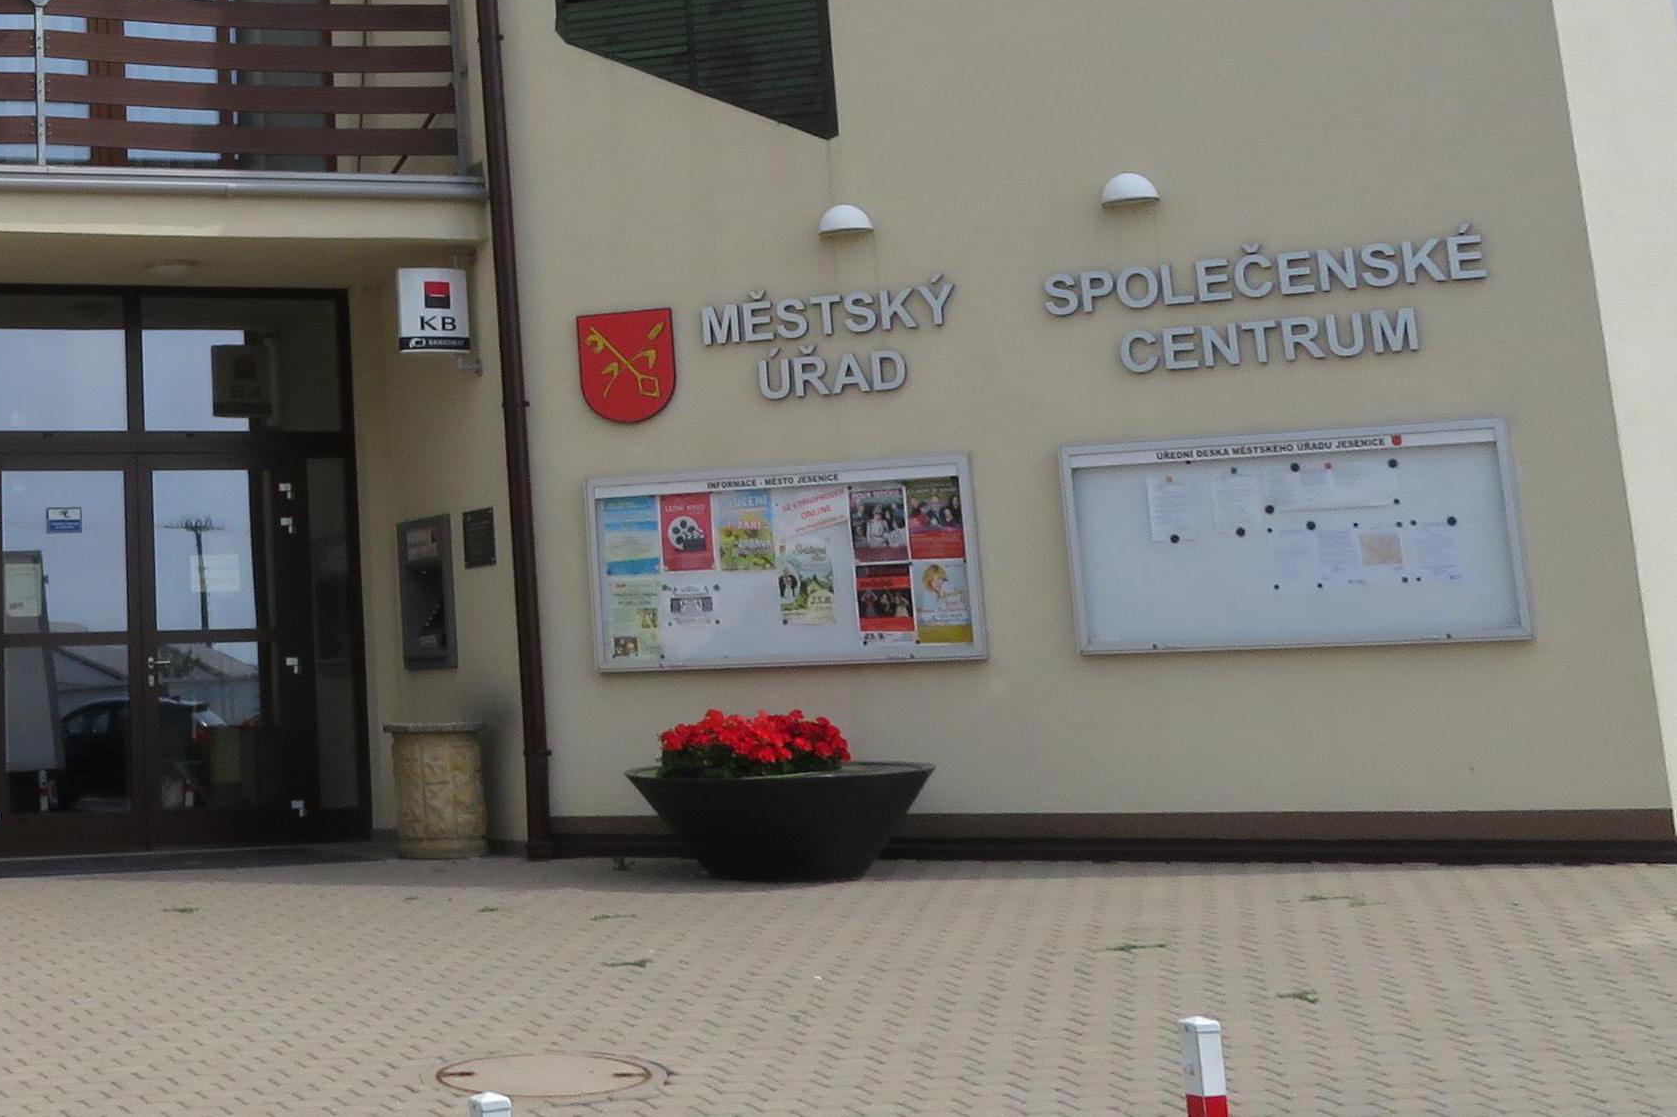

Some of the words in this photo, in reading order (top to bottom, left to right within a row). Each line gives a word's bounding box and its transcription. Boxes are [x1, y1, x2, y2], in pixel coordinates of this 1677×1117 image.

[1043, 223, 1488, 317] SPOLEČENSKÉ
[419, 315, 457, 331] KB
[701, 273, 954, 347] MĚSTSKÝ
[1119, 306, 1420, 374] CENTRUM
[756, 344, 908, 400] ÚŘAD
[1196, 447, 1229, 458] DESKA
[1231, 442, 1293, 455] MĚSTSKÉHO
[1335, 438, 1385, 449] JESENICE
[707, 479, 757, 490] INFORMACE
[765, 475, 794, 486] MĚSTO
[797, 474, 840, 484] JESENICE
